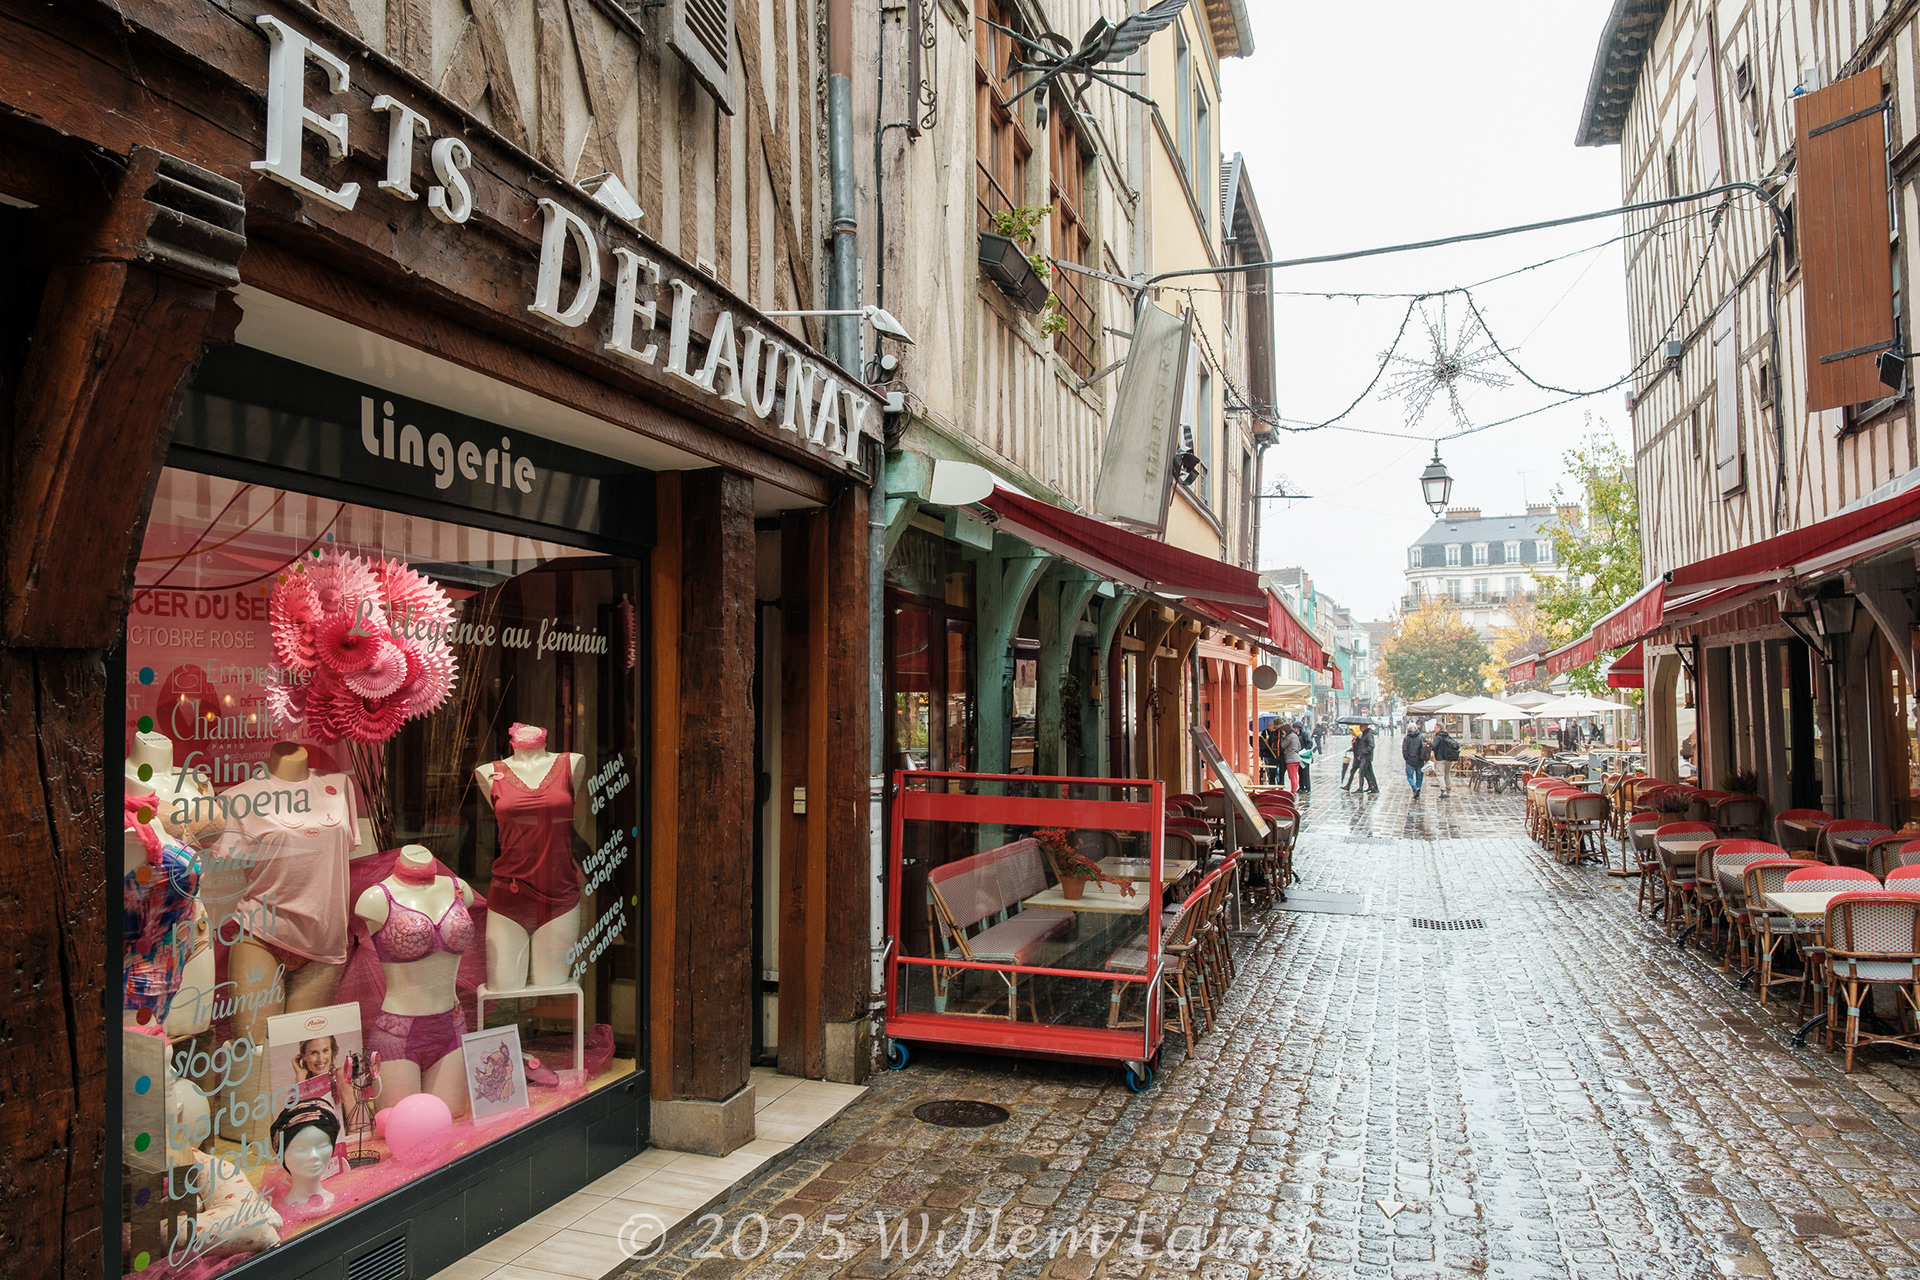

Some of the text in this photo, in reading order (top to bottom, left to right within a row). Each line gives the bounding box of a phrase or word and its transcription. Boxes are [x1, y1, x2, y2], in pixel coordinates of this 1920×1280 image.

[527, 197, 871, 466] DELAUNAY
[361, 395, 536, 493] Lingerie
[130, 589, 190, 618] CER
[194, 592, 229, 620] DU
[210, 630, 257, 649] ROSE
[501, 624, 532, 650] au
[536, 617, 609, 660] féminin
[205, 658, 312, 691] Empreinte
[171, 698, 280, 741] Chantelle
[171, 751, 271, 793] felina
[587, 752, 625, 797] Maillot
[591, 771, 630, 815] de bain
[170, 788, 311, 825] amoena
[181, 847, 256, 878] Anita
[585, 845, 628, 896] adaptée
[172, 893, 277, 957] marli
[565, 896, 624, 966] Chaussures
[572, 913, 627, 982] de confort
[170, 963, 286, 1026] Triumph
[169, 1026, 257, 1096] sloggi
[168, 1084, 300, 1151] barbara
[168, 1186, 275, 1268] Oscalito
